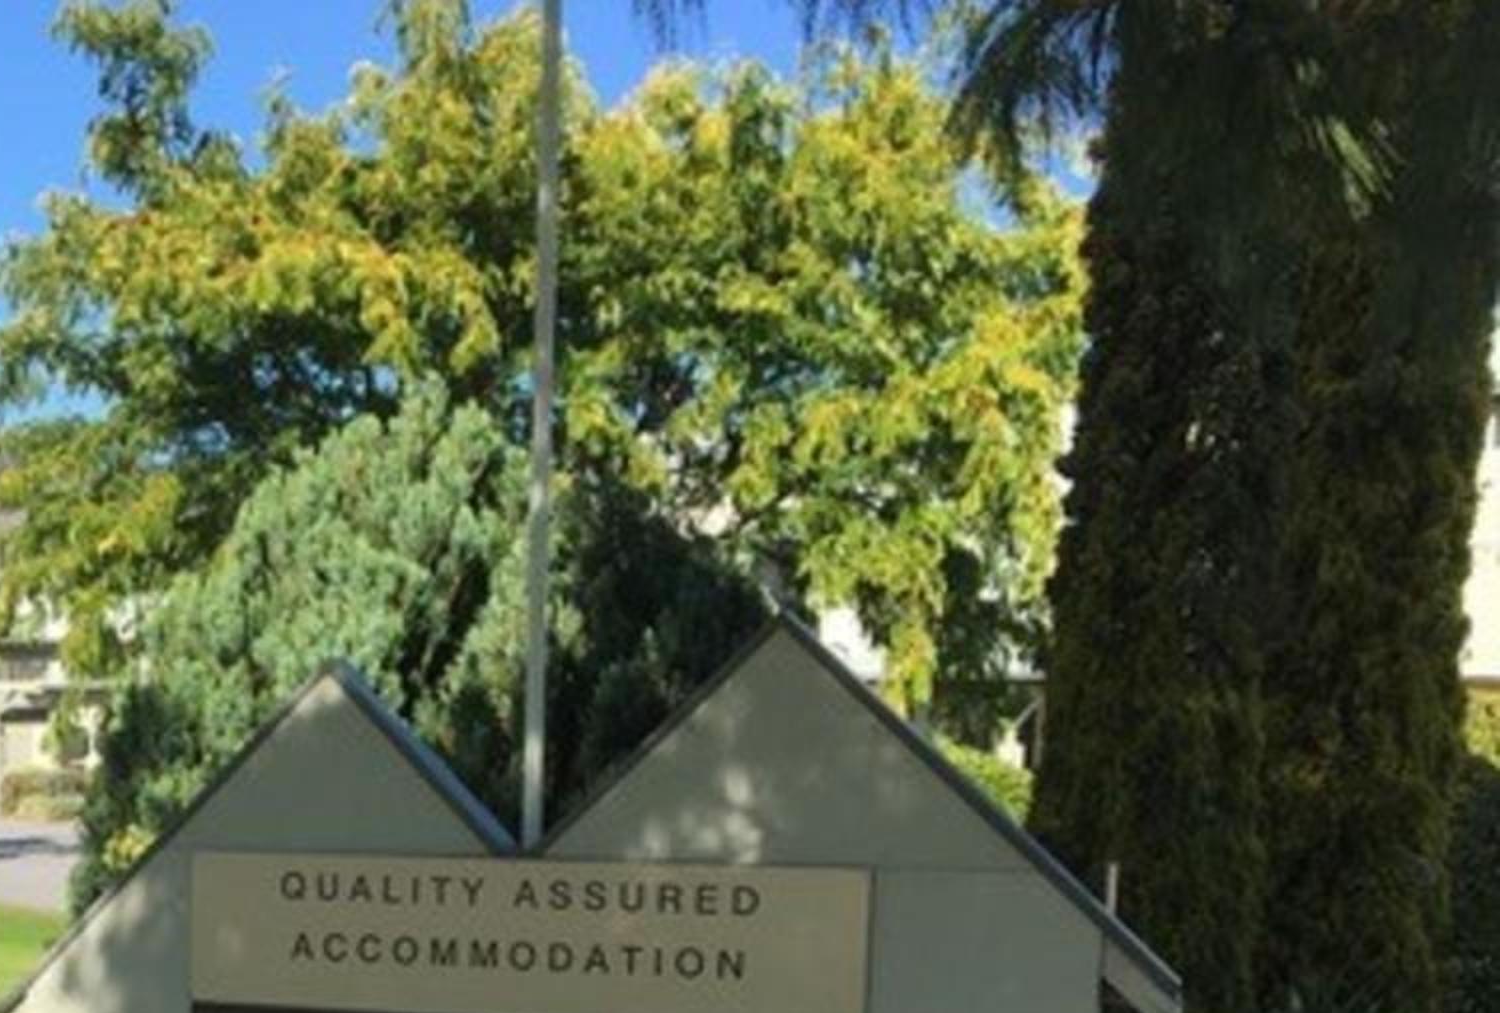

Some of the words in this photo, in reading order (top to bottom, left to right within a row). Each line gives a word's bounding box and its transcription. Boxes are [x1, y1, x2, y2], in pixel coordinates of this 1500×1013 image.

[280, 871, 484, 906] QUALITY
[513, 879, 762, 917] ASSURED
[291, 933, 748, 979] ACCOMMODATION
